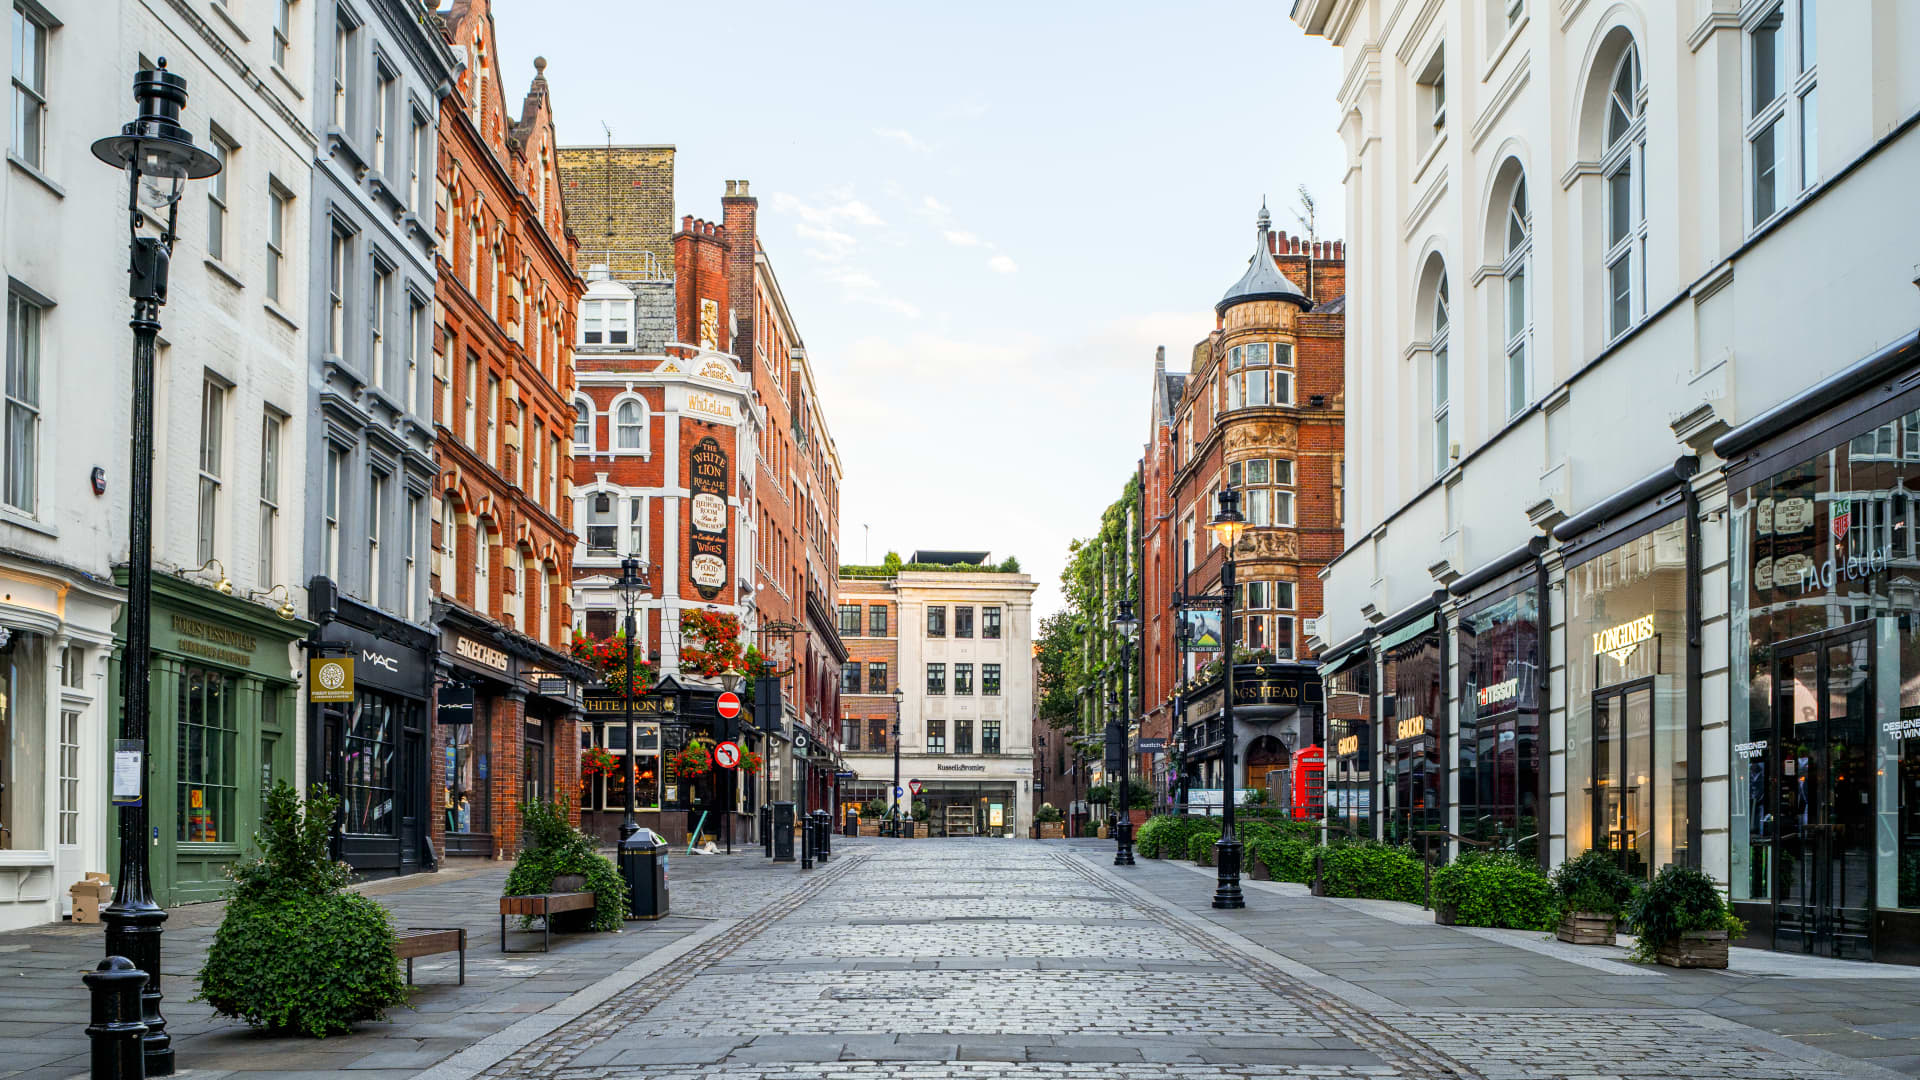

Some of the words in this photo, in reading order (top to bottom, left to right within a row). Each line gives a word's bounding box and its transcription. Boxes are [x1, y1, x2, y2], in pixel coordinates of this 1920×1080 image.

[702, 443, 718, 453] THE
[693, 451, 726, 468] WHITE
[698, 463, 722, 478] LION
[1832, 501, 1849, 516] TAG
[696, 541, 722, 555] WINES
[700, 564, 718, 573] FOOD
[1797, 559, 1832, 594] TAG
[1835, 543, 1891, 582] Heuer
[1592, 613, 1655, 656] LONGINES
[456, 635, 509, 672] SKECHERS
[1233, 687, 1256, 698] AGS
[1260, 686, 1298, 698] HEAD
[1487, 677, 1518, 704] TISSOT
[1398, 714, 1424, 740] GAUCHO
[1882, 718, 1920, 732] DESIGNE
[1889, 730, 1902, 741] TO
[1903, 728, 1920, 739] WIN
[1338, 734, 1358, 756] GAUCHO
[1734, 740, 1768, 752] DESIGNED
[1739, 751, 1748, 759] TO
[1749, 749, 1762, 758] WIN
